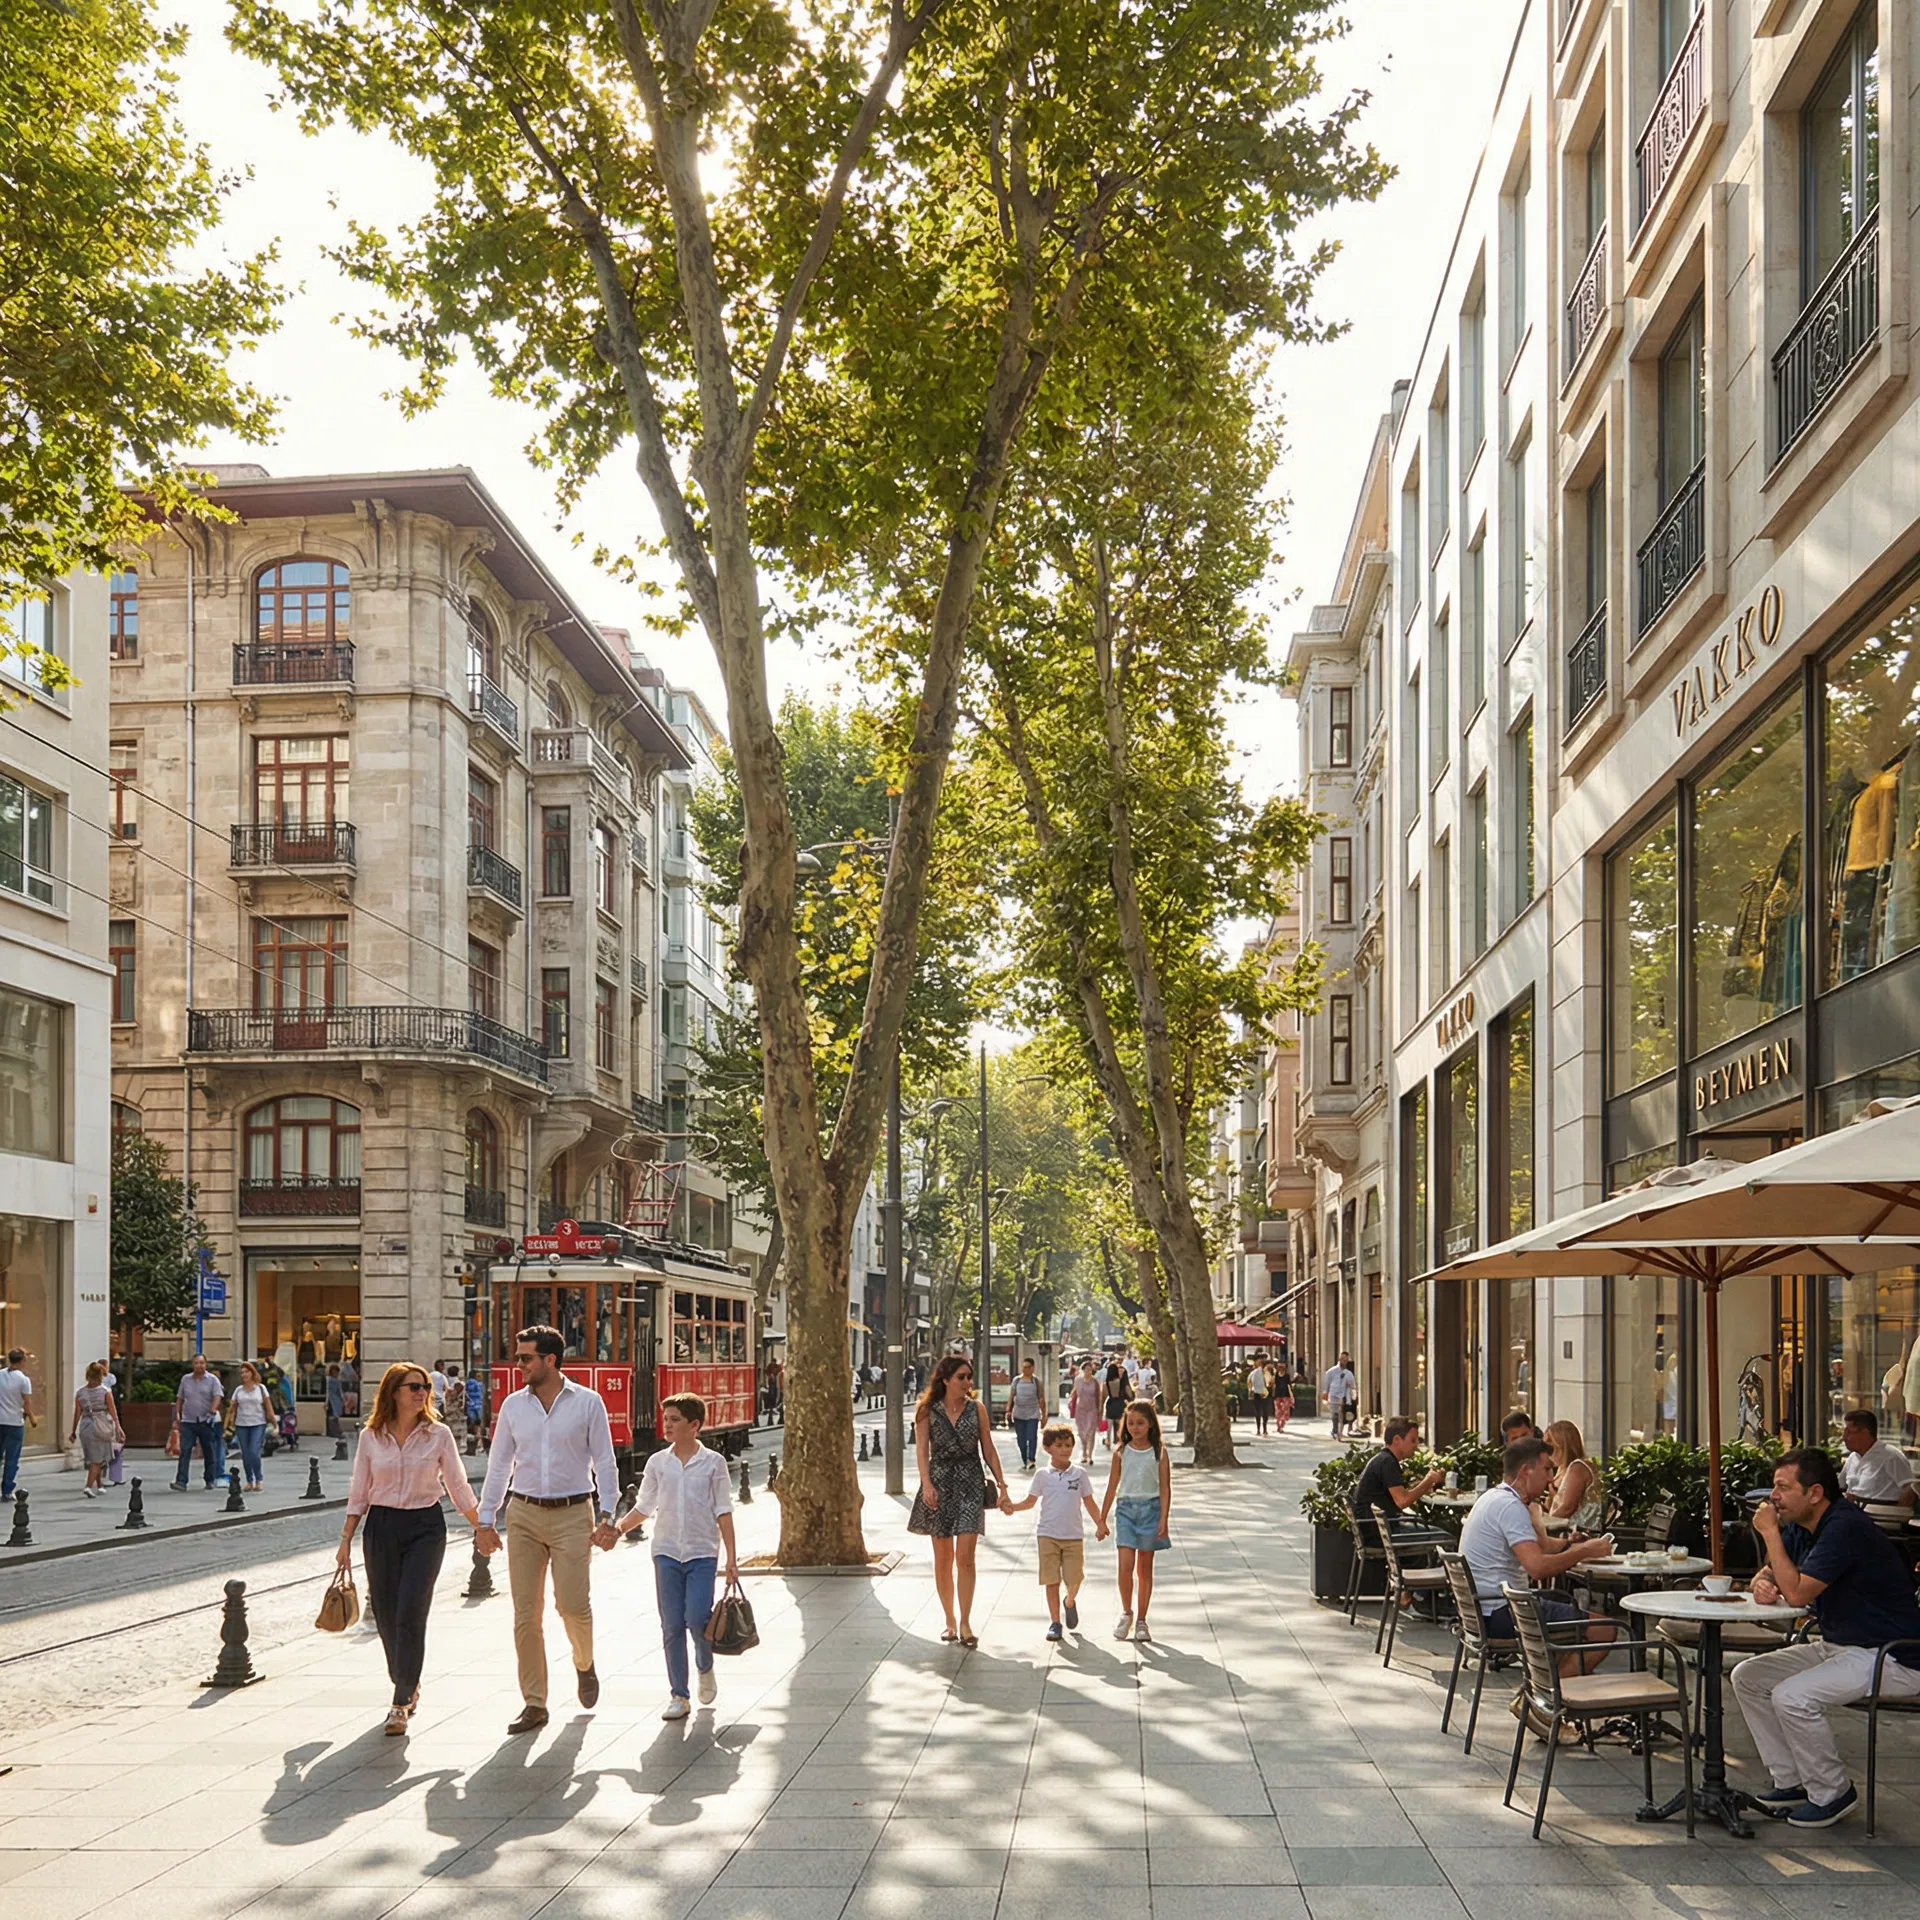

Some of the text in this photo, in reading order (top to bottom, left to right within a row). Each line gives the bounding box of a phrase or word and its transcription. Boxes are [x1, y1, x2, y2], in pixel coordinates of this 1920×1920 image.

[1670, 584, 1784, 738] VAKKO
[1695, 1037, 1792, 1112] BEYMEN
[561, 1222, 572, 1236] 3
